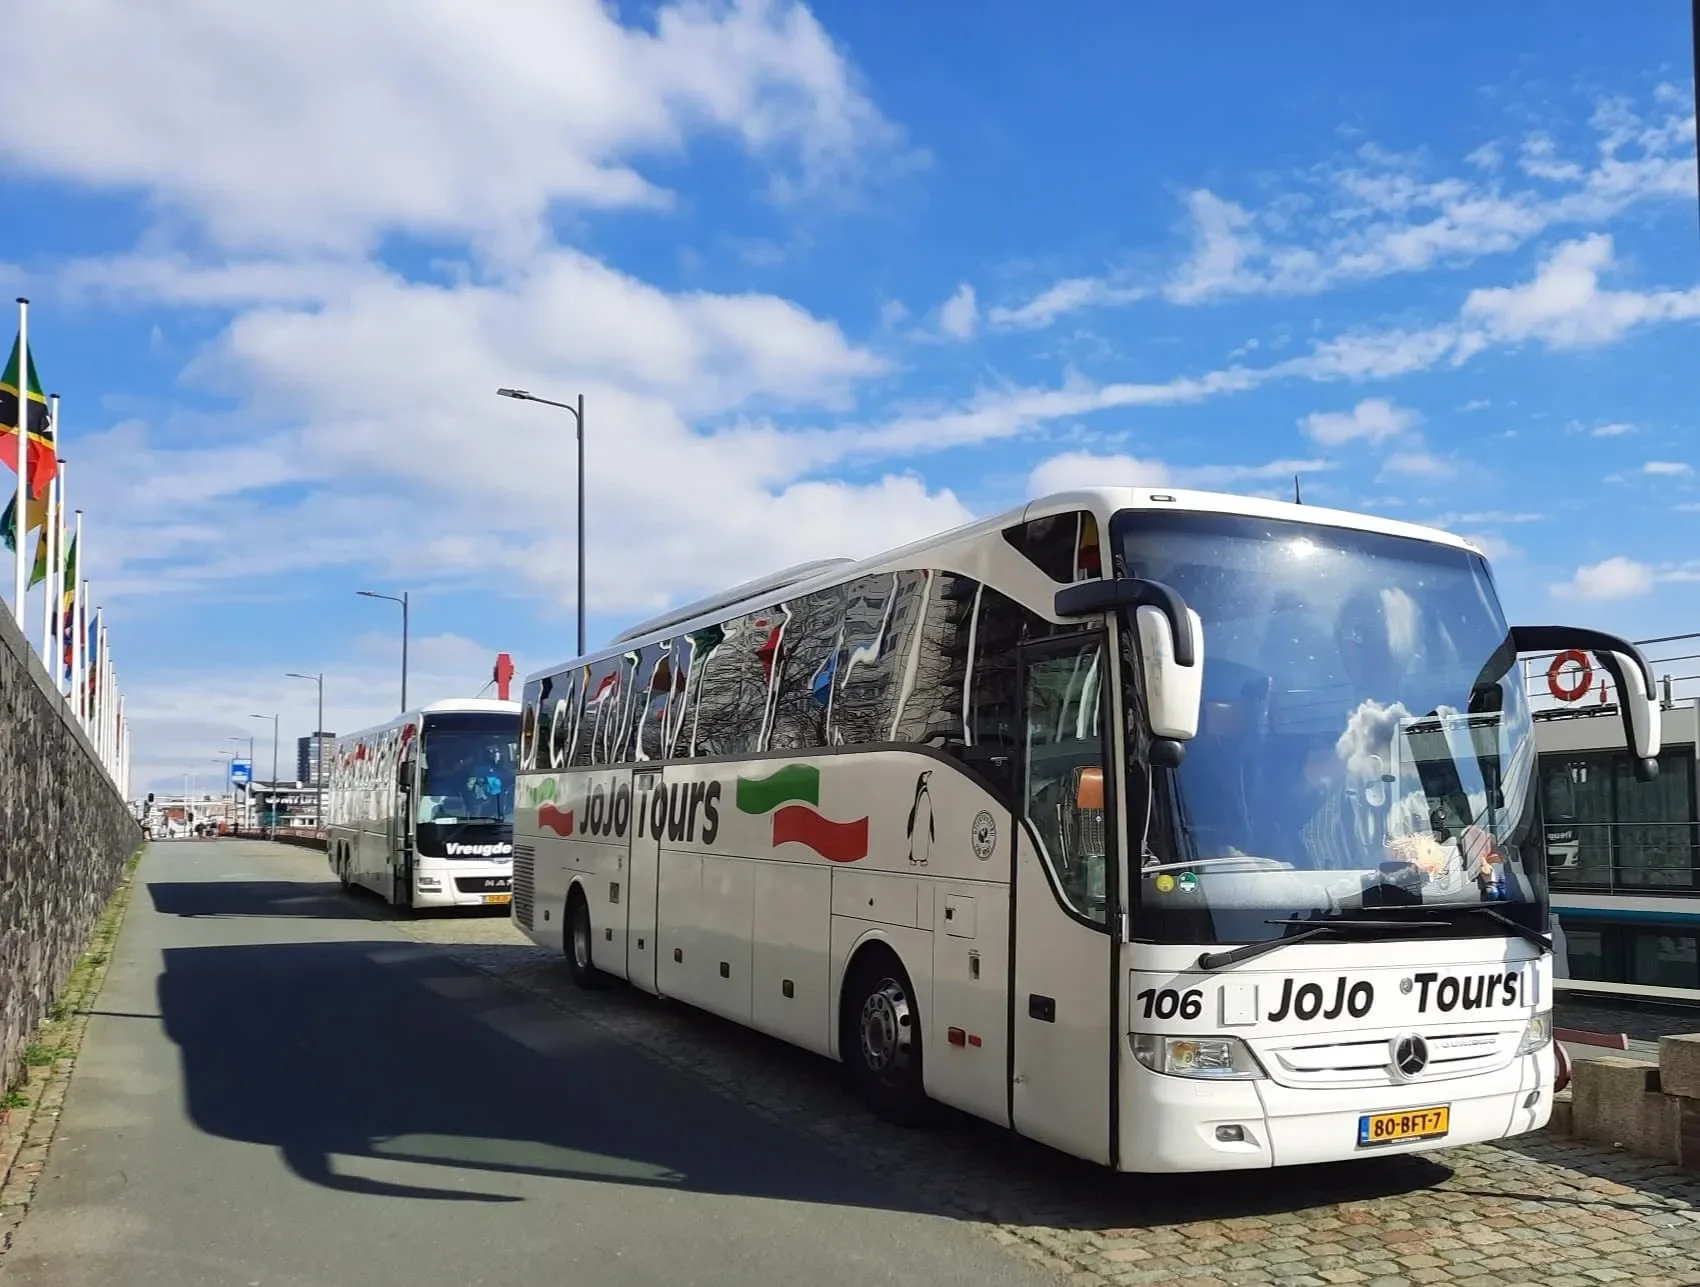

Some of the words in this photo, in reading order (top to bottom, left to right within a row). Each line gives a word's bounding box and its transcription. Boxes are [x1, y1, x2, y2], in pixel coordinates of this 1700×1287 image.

[579, 776, 630, 837] JoJo
[637, 779, 722, 845] Tours
[1137, 988, 1203, 1020] 106
[1268, 976, 1375, 1022] JoJo
[1413, 970, 1517, 1014] Tours
[1374, 1112, 1441, 1137] 80-BFT-7
